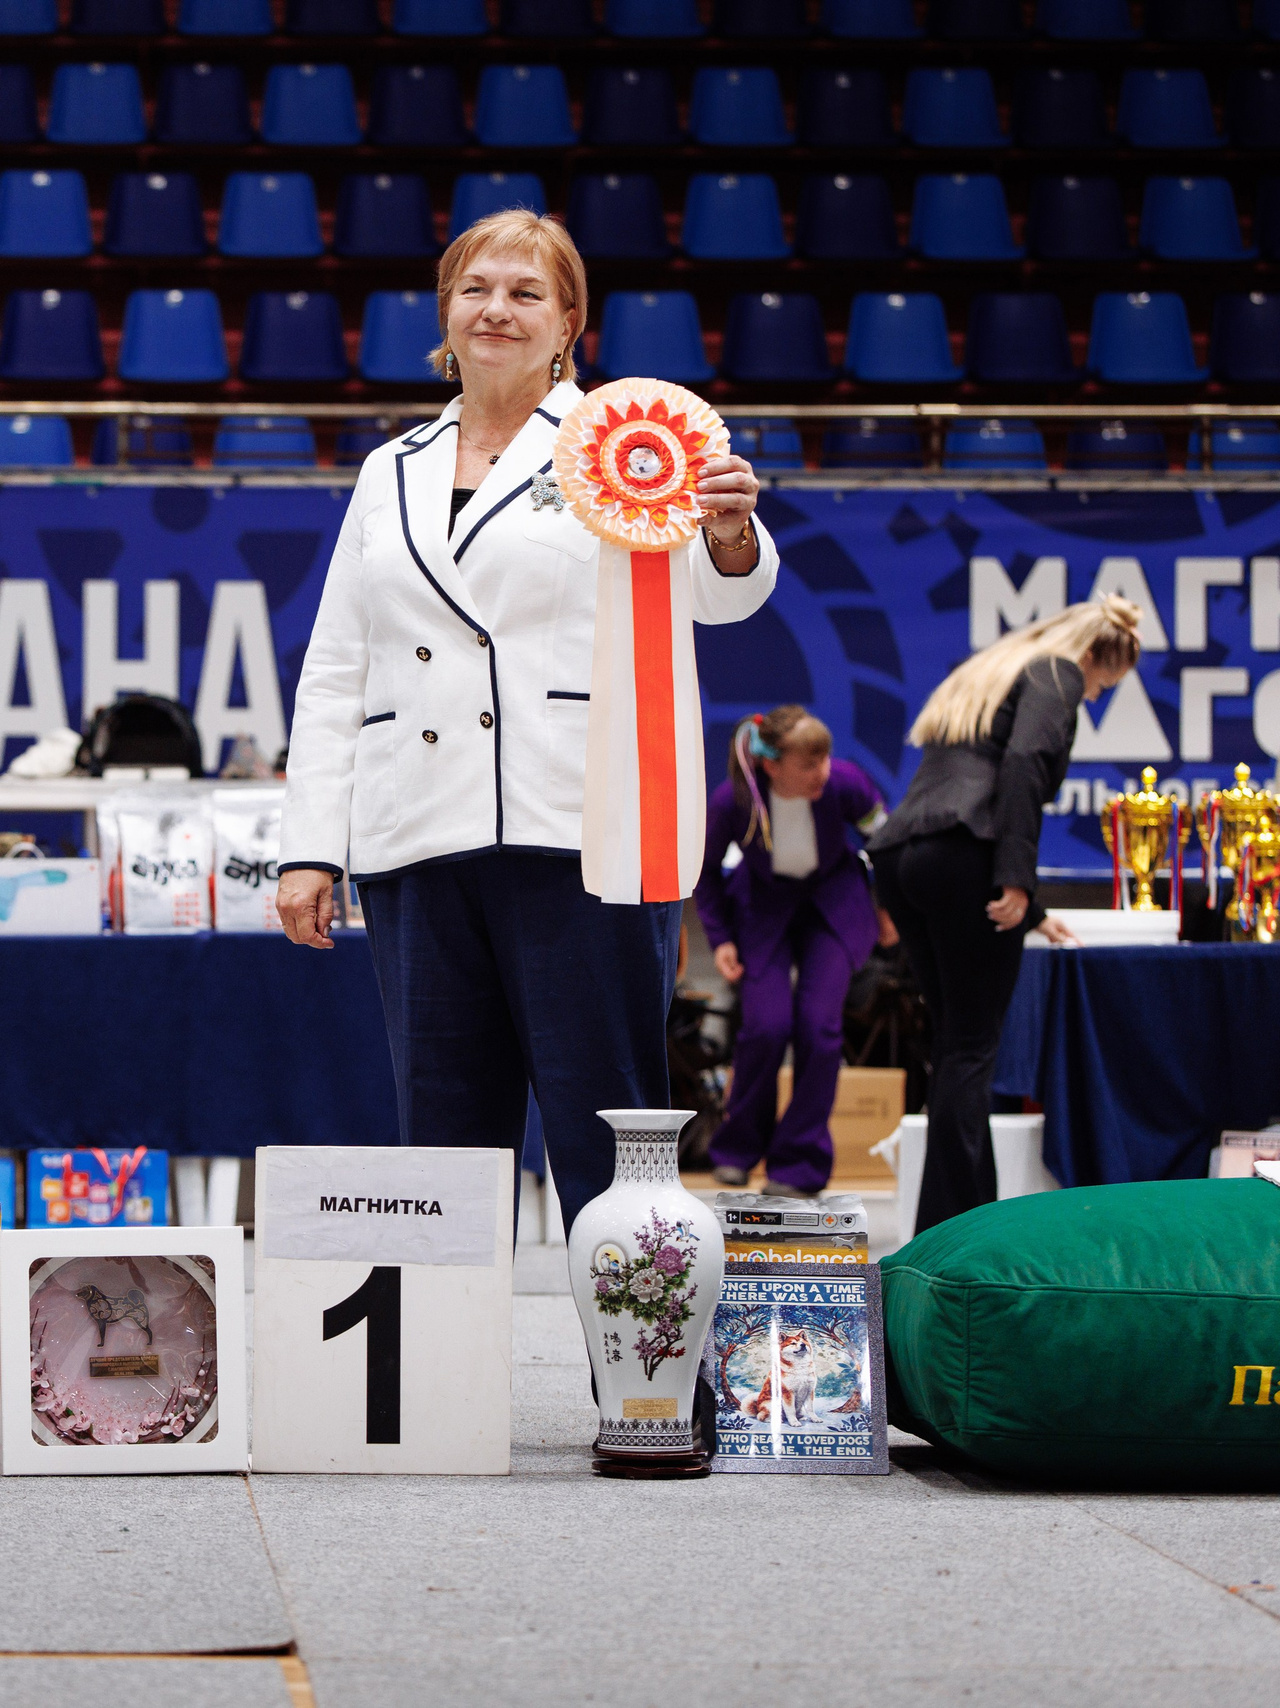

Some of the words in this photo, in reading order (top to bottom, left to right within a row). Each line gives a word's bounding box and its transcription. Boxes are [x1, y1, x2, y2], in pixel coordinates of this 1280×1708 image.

[320, 1196, 443, 1216] МАГНИТКА
[727, 1213, 738, 1221] 1+
[762, 1283, 805, 1292] UPON
[809, 1284, 820, 1293] A
[824, 1284, 865, 1295] TIME;
[719, 1292, 767, 1301] THERE
[772, 1293, 808, 1302] WAS
[813, 1294, 825, 1303] A
[830, 1294, 865, 1303] GIRL
[322, 1266, 402, 1444] 1
[1228, 1365, 1280, 1405] П
[719, 1434, 749, 1443] WHO
[752, 1435, 794, 1444] REALY
[797, 1436, 835, 1445] LOVED
[838, 1437, 870, 1446] DOGS
[718, 1444, 732, 1454] IT
[735, 1445, 770, 1454] WAS
[803, 1446, 832, 1456] THE
[836, 1446, 871, 1456] END.
